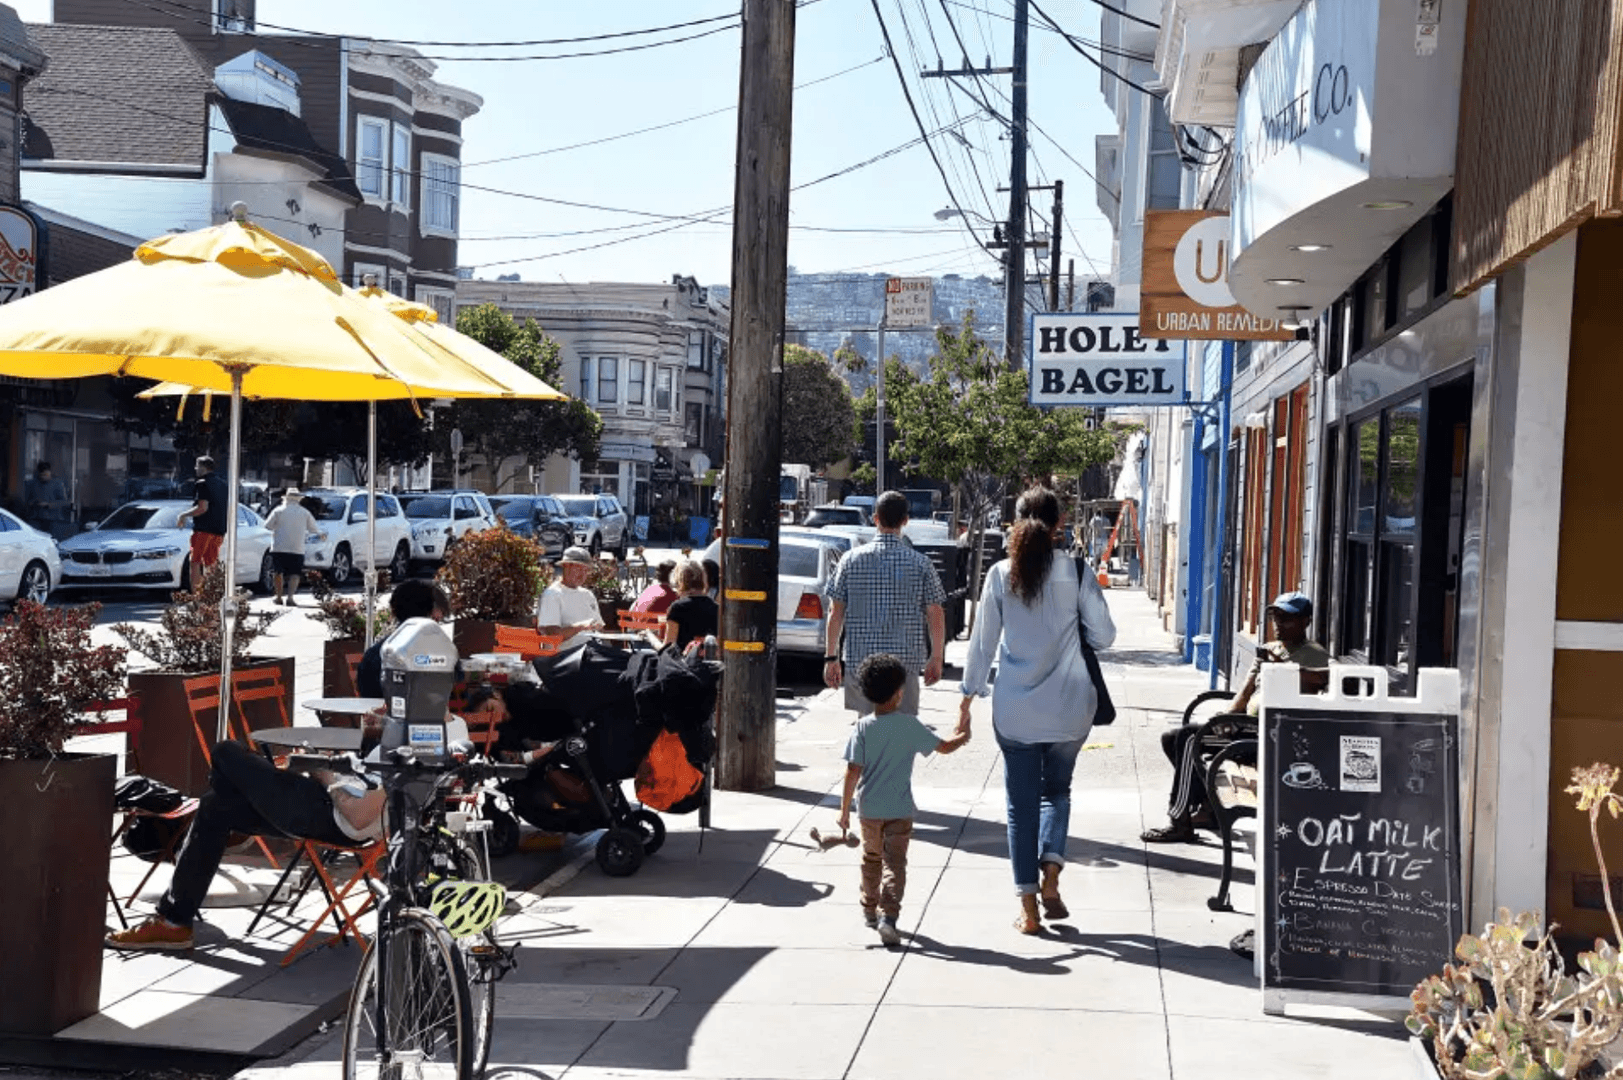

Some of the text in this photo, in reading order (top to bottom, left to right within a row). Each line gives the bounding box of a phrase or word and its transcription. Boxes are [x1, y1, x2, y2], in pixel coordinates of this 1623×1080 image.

[1314, 62, 1353, 125] CO.
[1195, 239, 1229, 283] U
[1157, 312, 1210, 331] URBAN
[1040, 368, 1174, 394] BAGEL
[1298, 812, 1361, 847] OAT
[1319, 850, 1433, 880] LATTE
